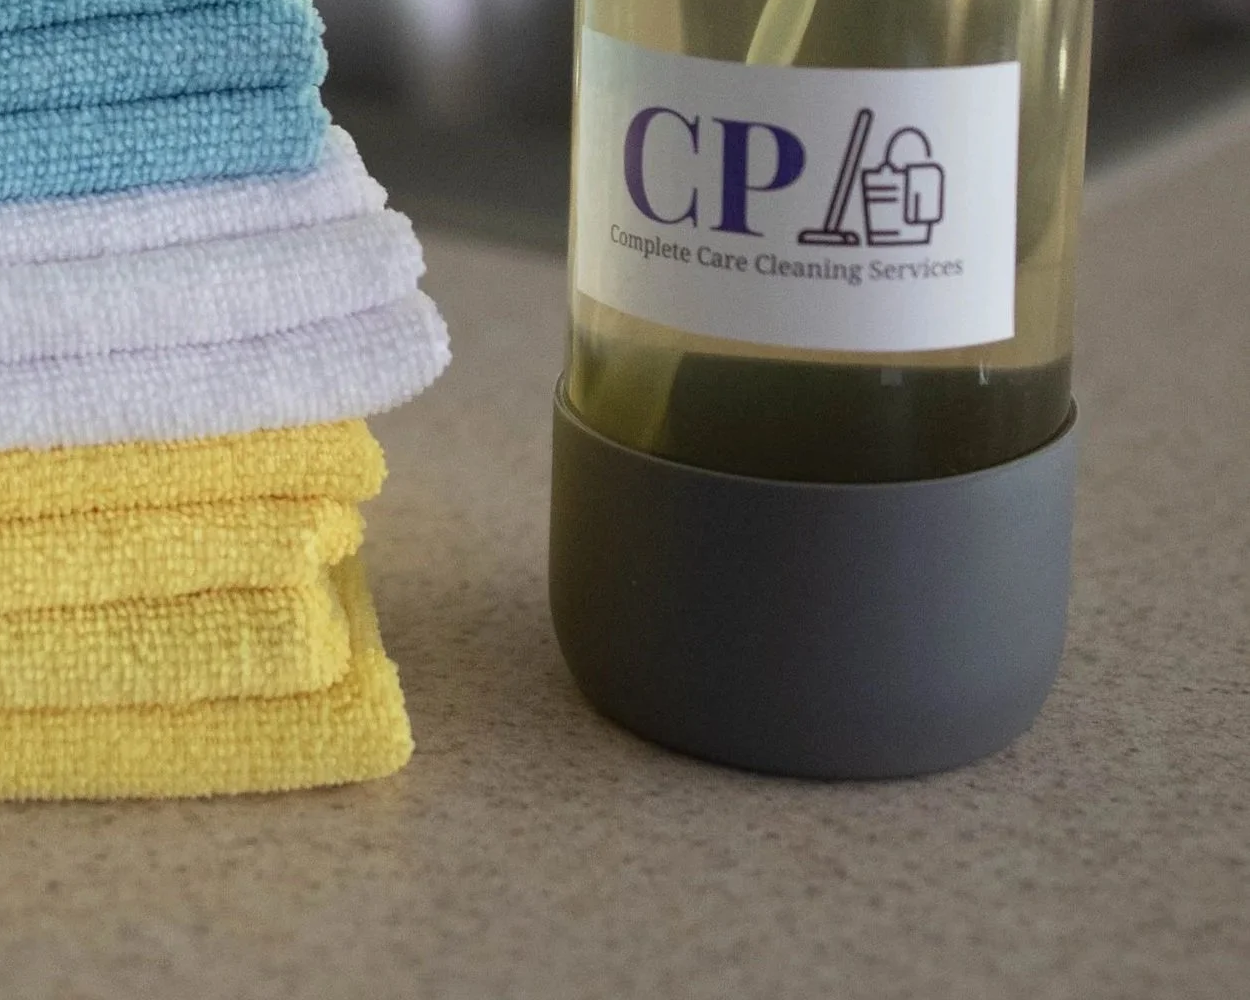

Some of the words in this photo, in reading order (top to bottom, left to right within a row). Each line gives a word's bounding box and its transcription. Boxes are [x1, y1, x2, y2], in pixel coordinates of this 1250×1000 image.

[623, 106, 807, 237] CP
[610, 224, 691, 262] Complete
[697, 246, 748, 273] Care
[755, 253, 863, 286] Cleaning
[869, 258, 964, 282] Services
